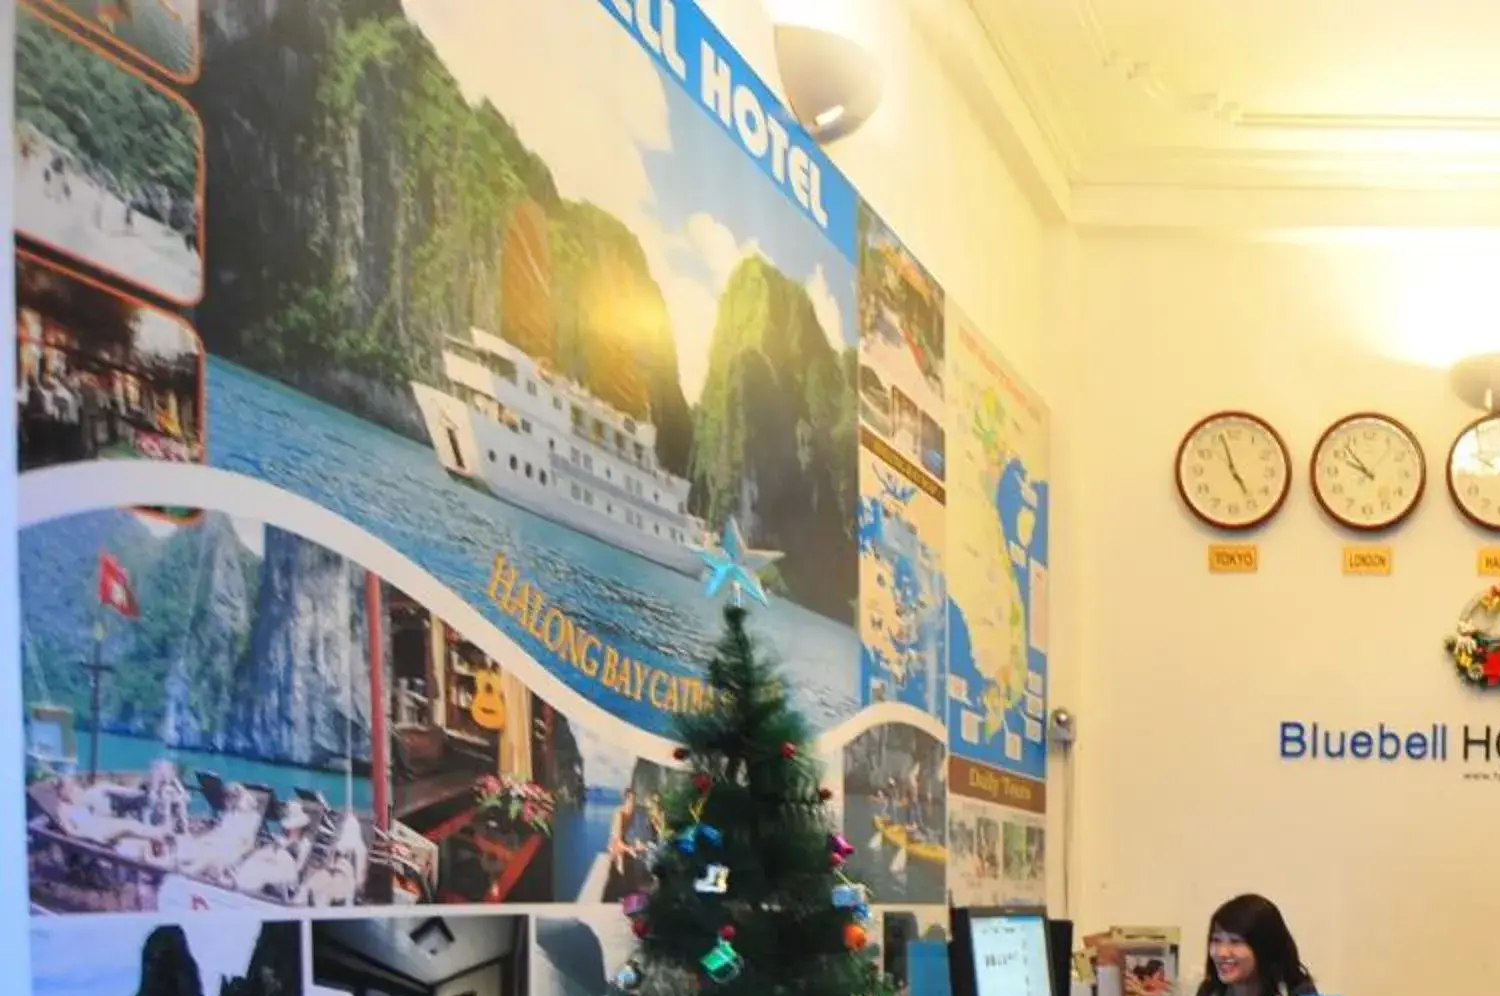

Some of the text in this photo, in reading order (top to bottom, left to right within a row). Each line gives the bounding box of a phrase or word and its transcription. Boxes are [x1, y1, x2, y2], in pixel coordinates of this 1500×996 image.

[701, 38, 829, 229] HOTEL
[1214, 551, 1254, 566] TOKYO
[1349, 553, 1386, 569] LONDON
[487, 549, 602, 677] HALONG
[602, 644, 651, 702] BAY
[1279, 721, 1448, 761] Bluebell
